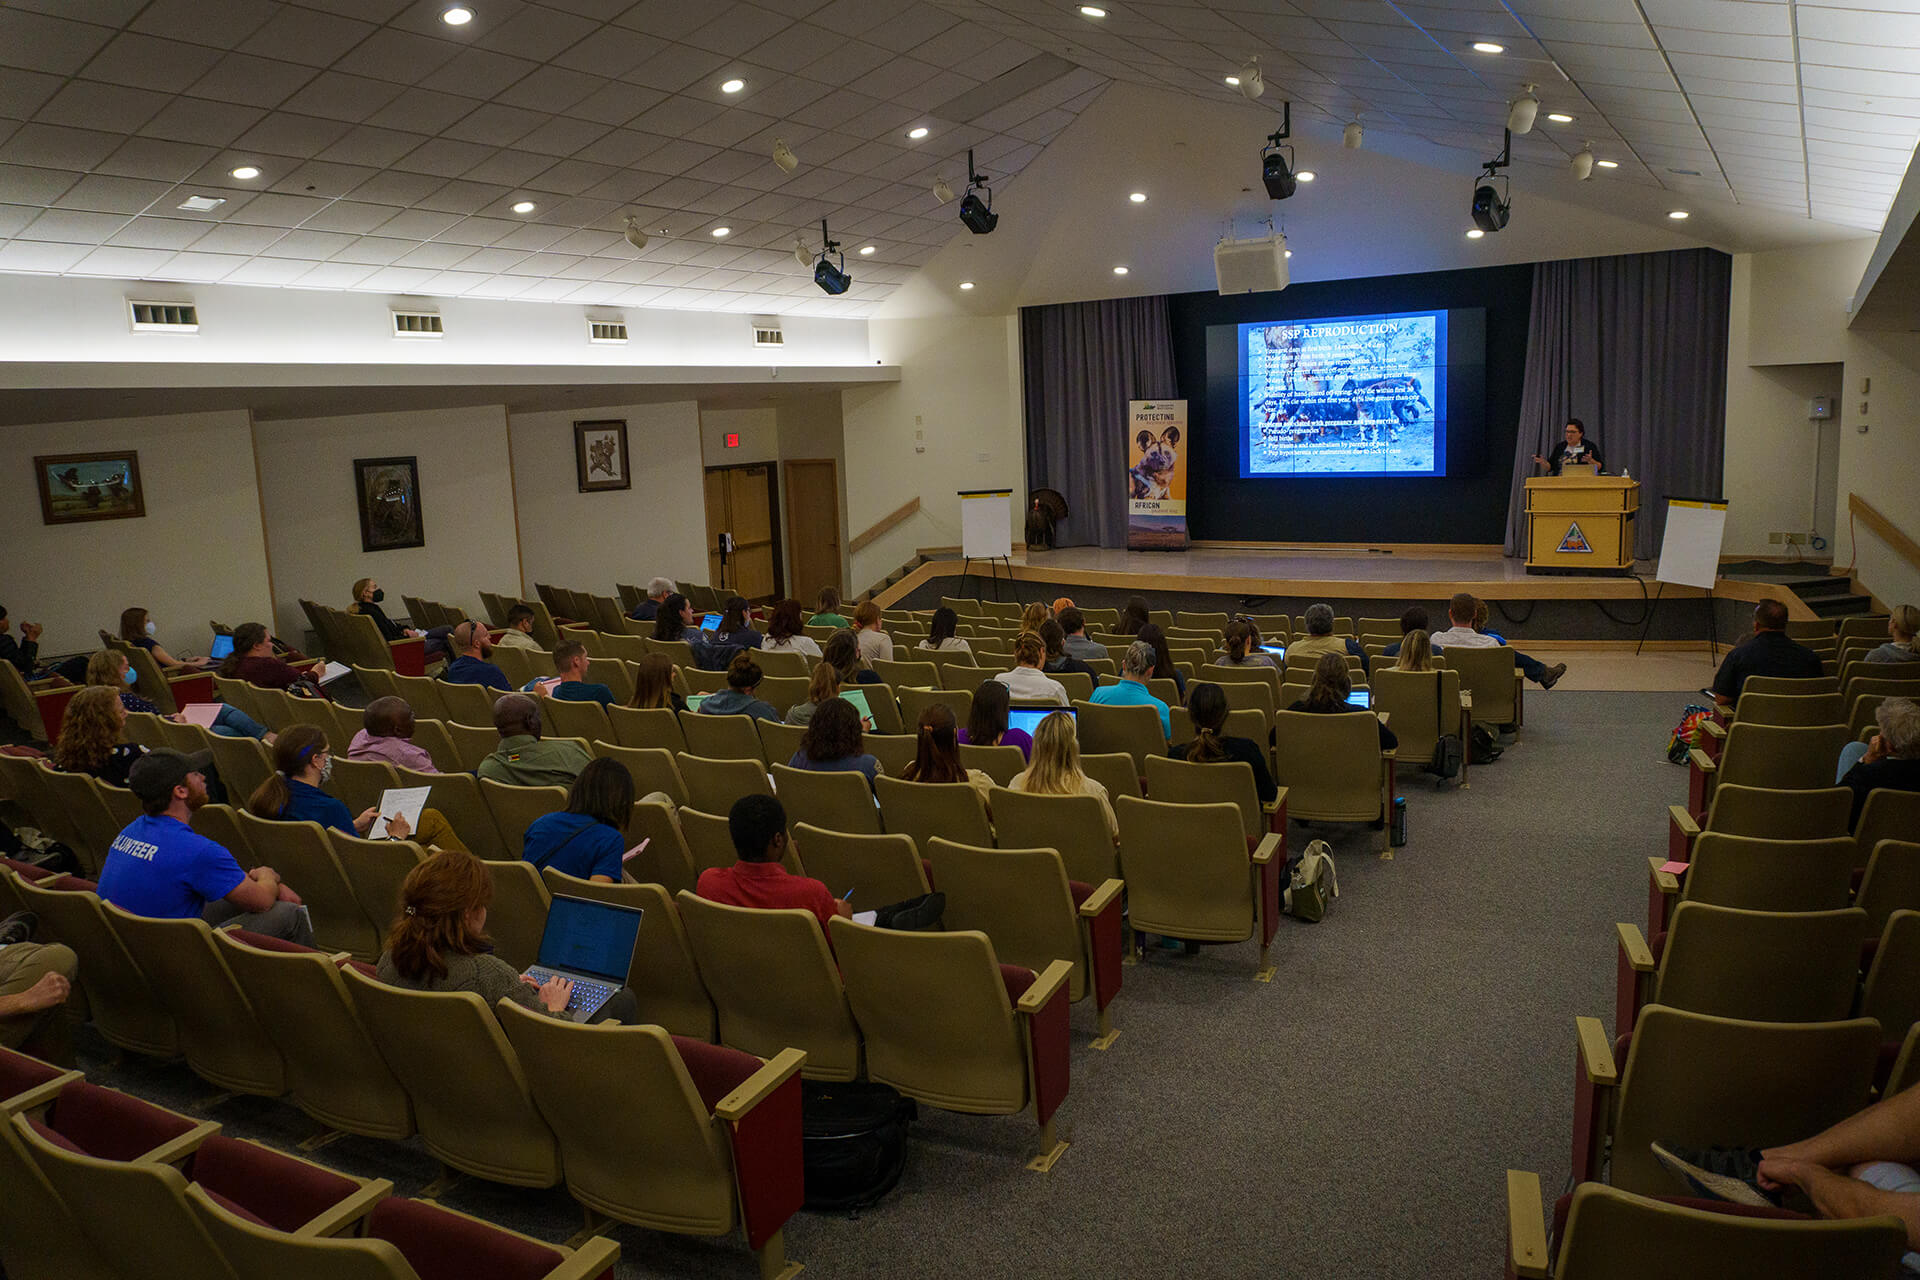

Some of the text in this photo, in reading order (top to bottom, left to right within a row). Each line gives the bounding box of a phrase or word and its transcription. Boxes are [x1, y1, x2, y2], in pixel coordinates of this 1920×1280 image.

[1281, 323, 1398, 340] SSP REPRODUCTION
[1136, 413, 1175, 422] PROTECTING
[1134, 501, 1160, 510] AFRICAN
[112, 834, 159, 862] LUNTEER
